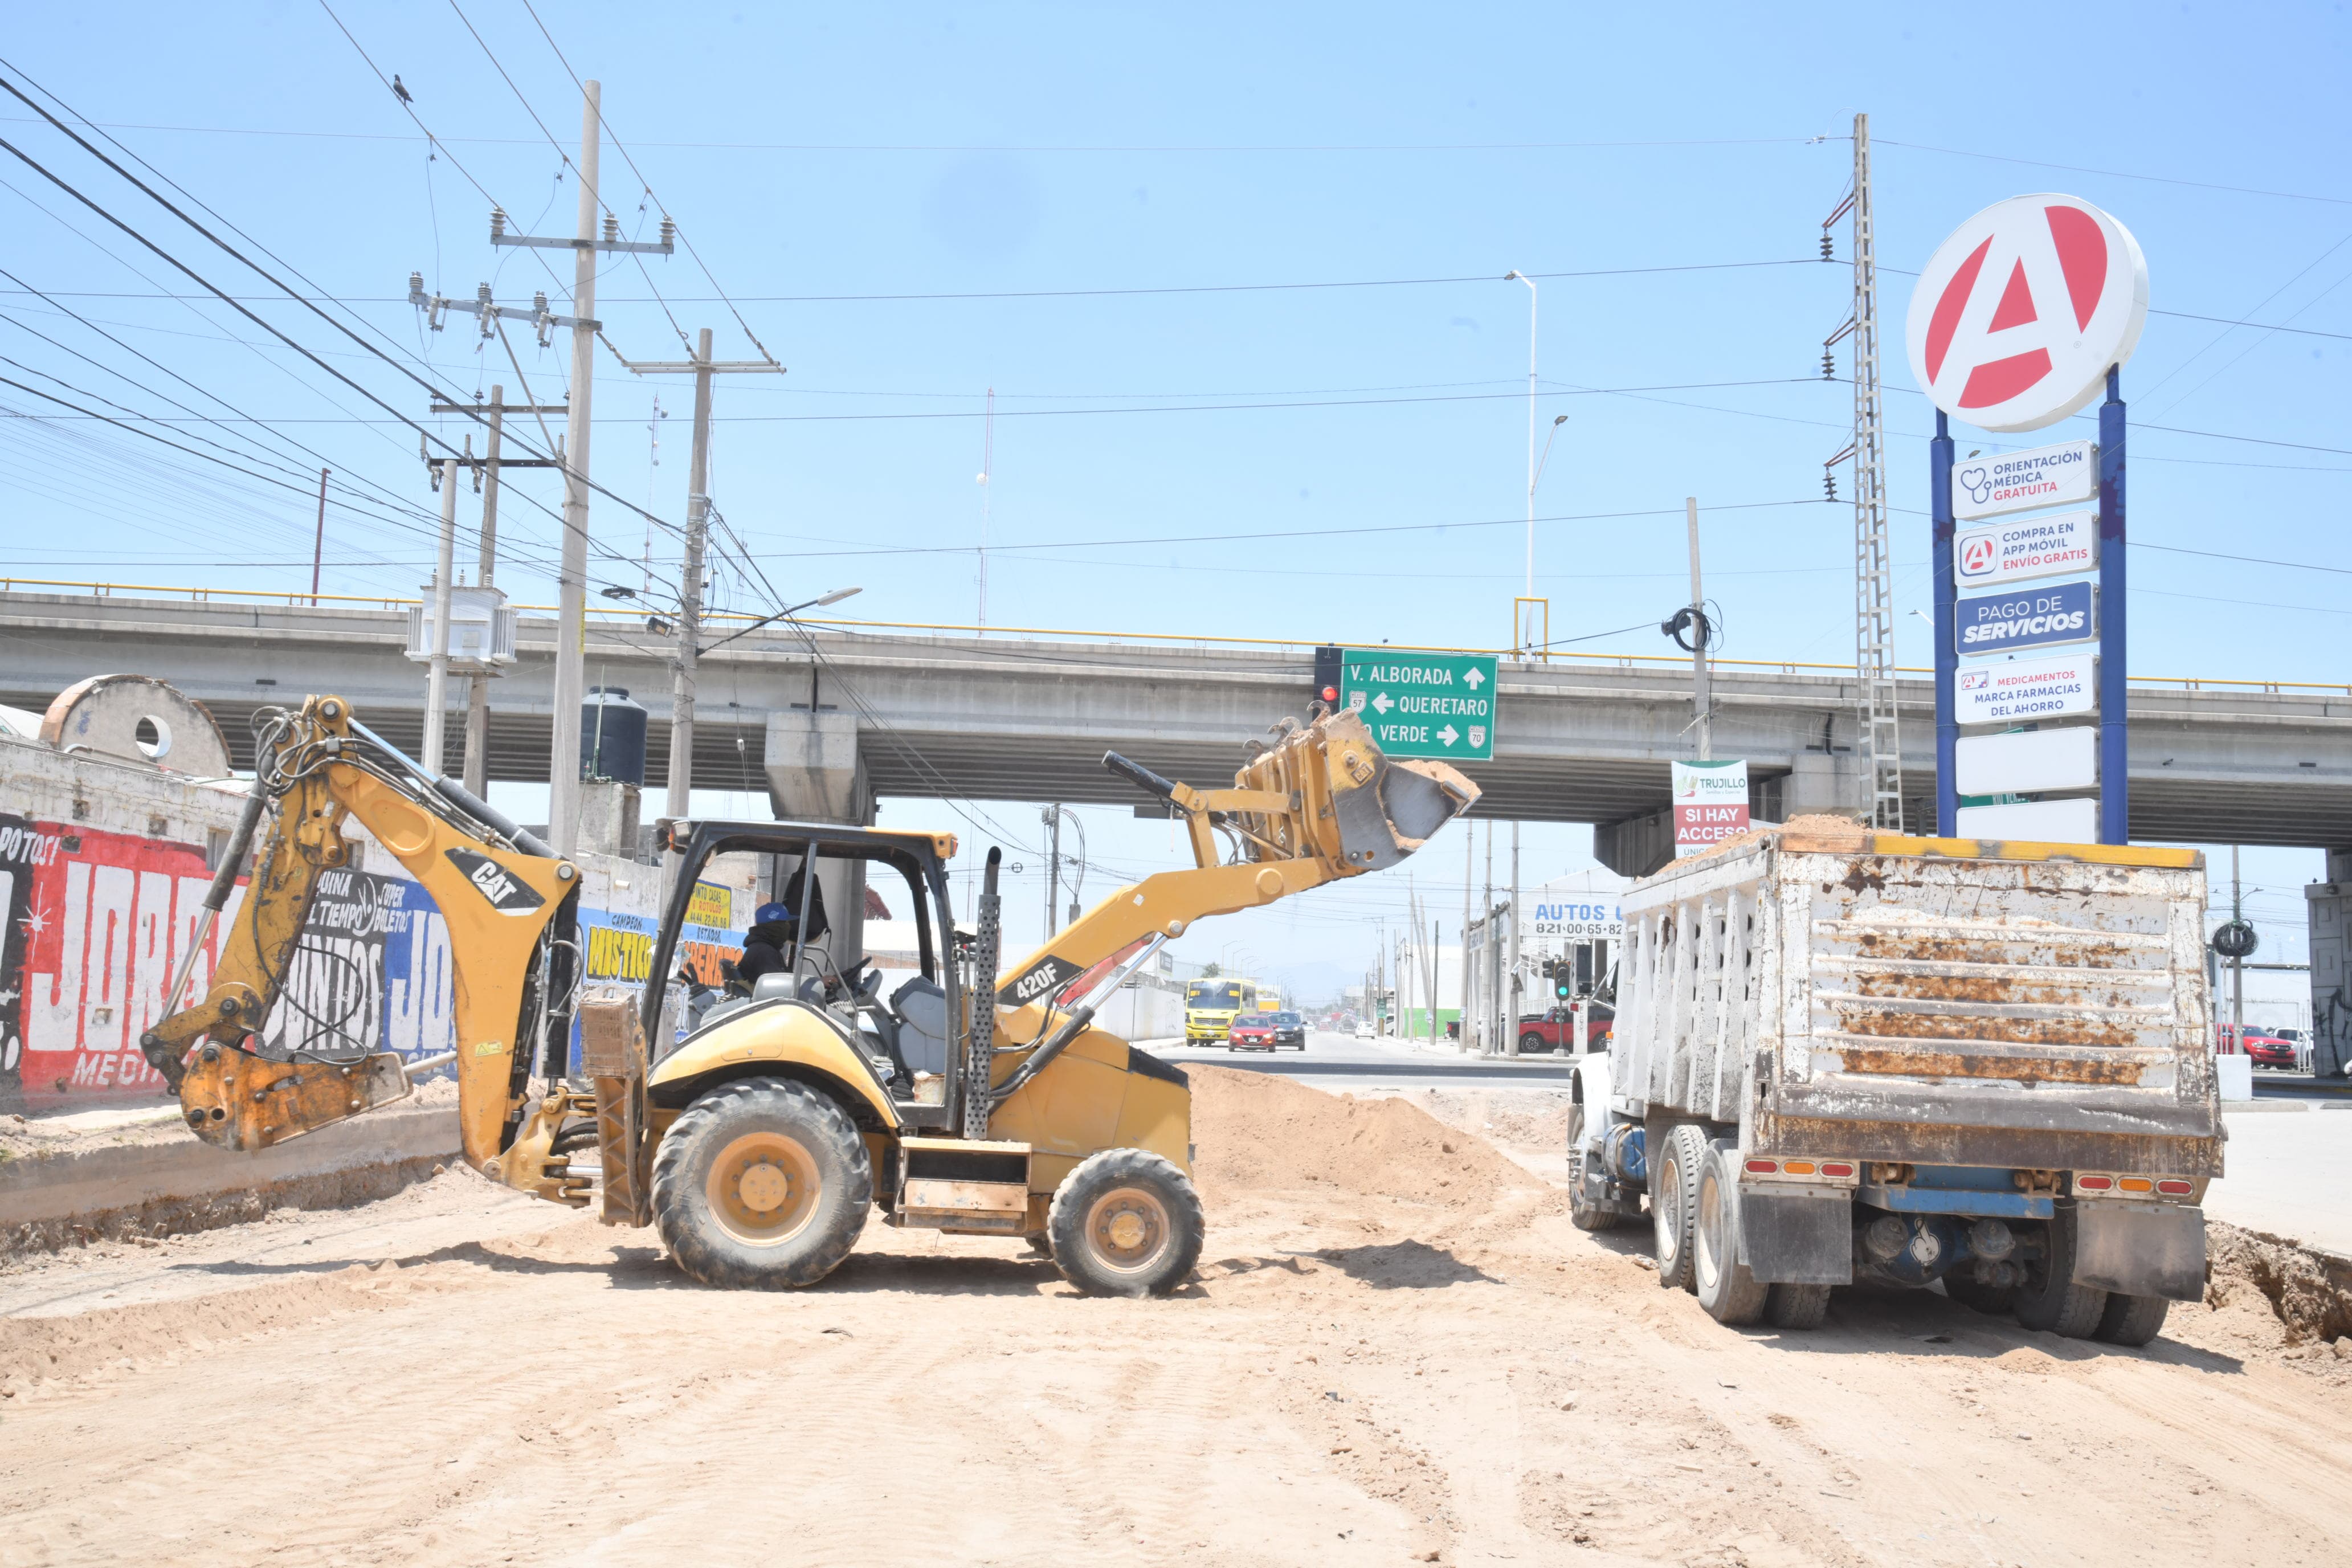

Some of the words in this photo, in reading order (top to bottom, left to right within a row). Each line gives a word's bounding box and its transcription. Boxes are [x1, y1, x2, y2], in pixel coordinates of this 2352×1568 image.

[1994, 451, 2081, 475] ORIENTACIÓN
[1994, 471, 2042, 488] MÉDICA
[1994, 481, 2057, 500] GRATUITA
[2003, 526, 2055, 542] COMPRA
[2058, 523, 2074, 533] EN
[2003, 545, 2025, 556] APP
[2028, 538, 2068, 552] MÓVIL
[2003, 555, 2040, 570] ENVÍO
[2044, 549, 2088, 564] GRATIS
[1978, 601, 2030, 622] PAGO
[2037, 596, 2062, 613] DE
[1963, 611, 2085, 643] SERVICIOS
[1350, 665, 1363, 681] V.
[1370, 665, 1453, 685] ALBORADA
[1998, 671, 2076, 686] MEDICAMENTOS
[1975, 691, 2014, 703] MARCA
[2017, 684, 2081, 699] FARMACIAS
[1399, 696, 1488, 716] QUERETARO
[1991, 707, 2011, 716] DEL
[2014, 700, 2064, 714] AHORRO
[1380, 724, 1429, 742] VERDE
[1472, 733, 1481, 742] 70
[1700, 778, 1746, 789] TRUJILLO
[1685, 808, 1701, 822] SI
[1705, 808, 1739, 822] HAY
[316, 871, 353, 897] UINA
[471, 861, 517, 904] CAT
[378, 883, 406, 908] SUPER
[320, 901, 363, 929] TIEMPO
[373, 907, 411, 933] BOLETOS
[1535, 904, 1605, 921] AUTOS
[612, 915, 643, 930] CAMPEON
[587, 926, 652, 981] MISTICO
[1016, 962, 1057, 998] 420F
